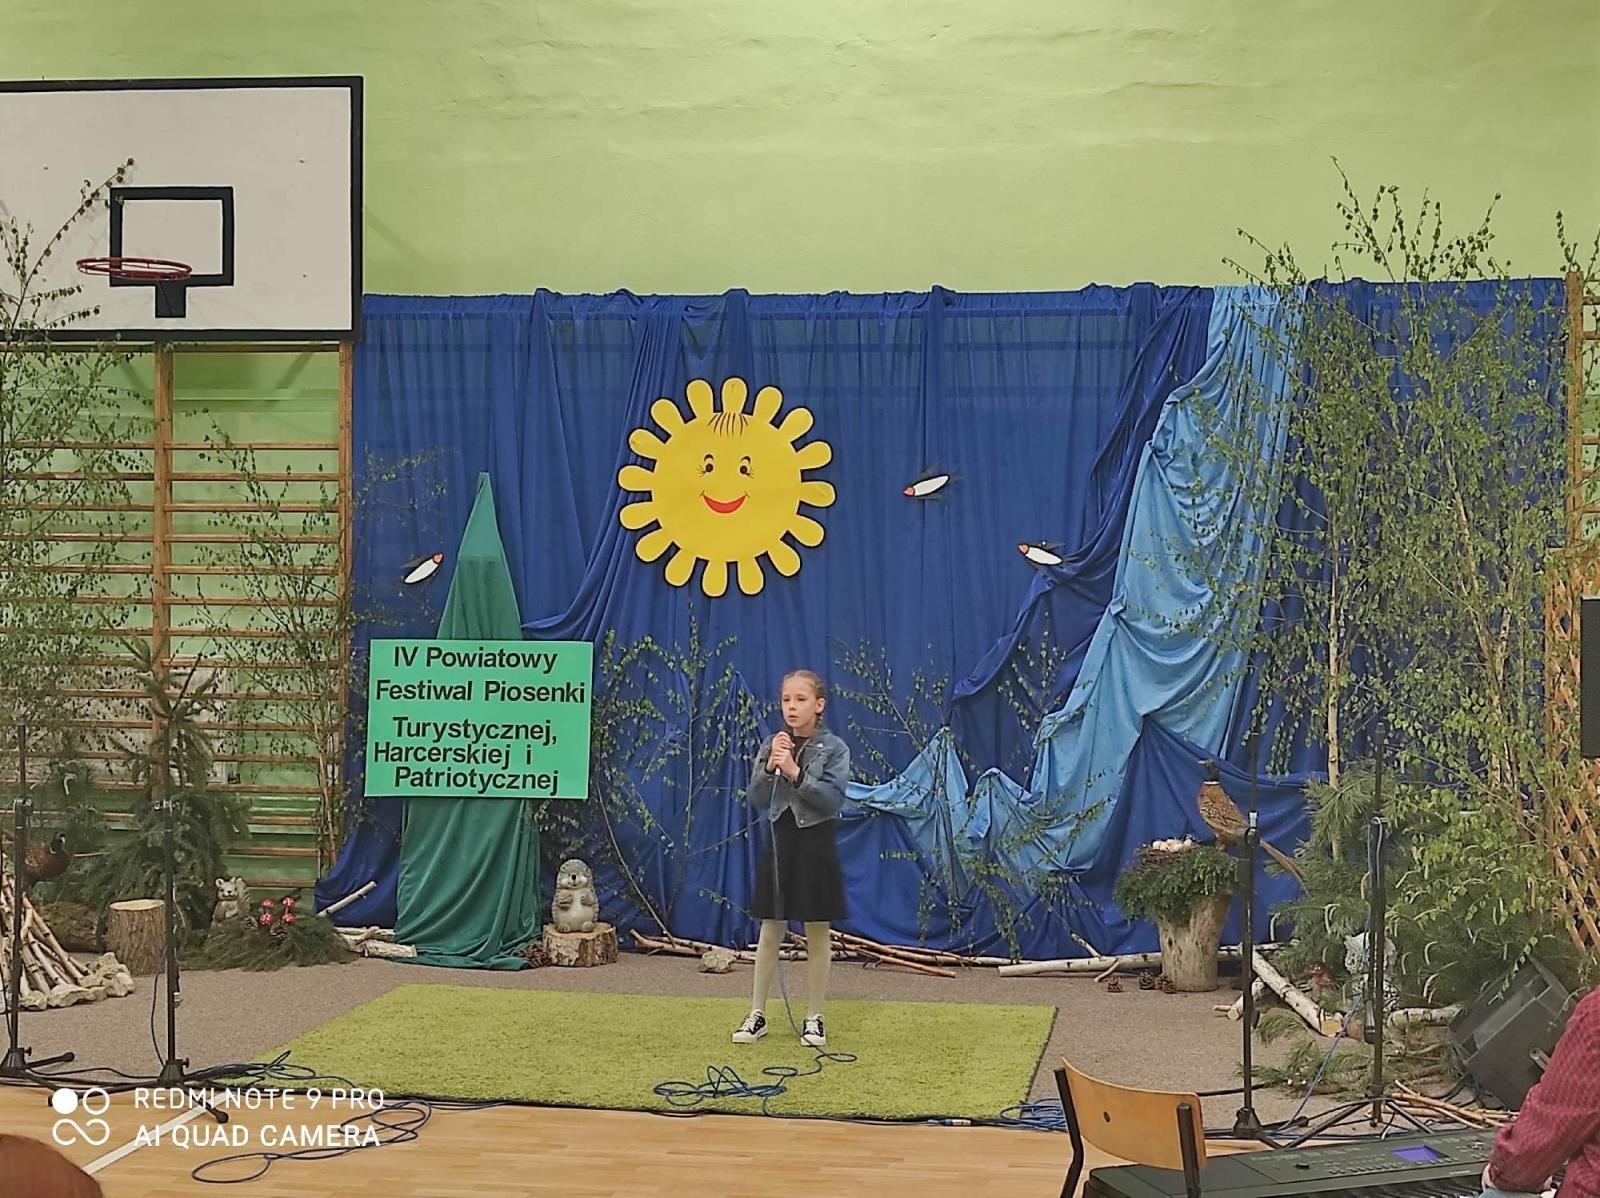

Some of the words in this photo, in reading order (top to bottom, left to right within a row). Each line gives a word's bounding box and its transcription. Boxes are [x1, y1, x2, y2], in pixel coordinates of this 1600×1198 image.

[394, 646, 419, 667] IV
[426, 646, 558, 674] Powiatowy
[376, 679, 473, 701] Festiwal
[484, 680, 586, 704] Piosenki
[392, 716, 557, 746] Turystycznej,
[374, 741, 511, 770] Harcerskiej
[525, 744, 532, 765] i
[394, 766, 559, 796] Patriotycznej
